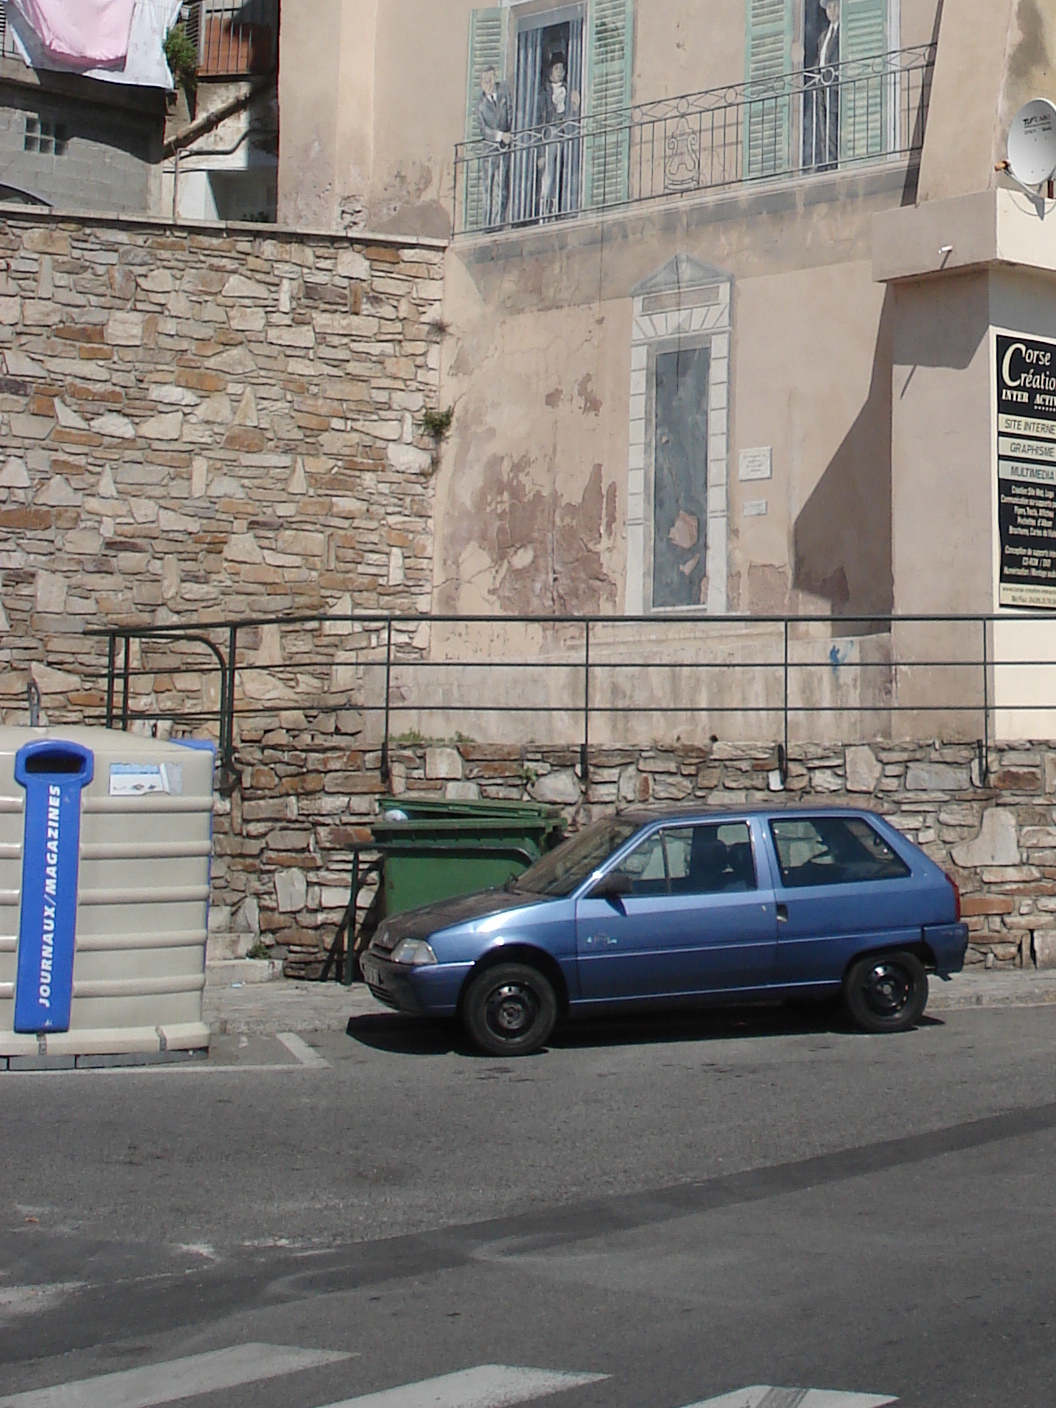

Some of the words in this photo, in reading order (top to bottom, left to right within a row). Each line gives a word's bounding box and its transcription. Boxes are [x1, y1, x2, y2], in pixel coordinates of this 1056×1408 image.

[1002, 343, 1051, 377] Corse
[1002, 389, 1029, 403] INTER
[1004, 418, 1022, 431] SITE
[1010, 442, 1055, 457] GRAPHISME
[1010, 465, 1055, 481] MULTIMEDIA
[38, 784, 62, 1008] JOURNAUX/MAGAZINES
